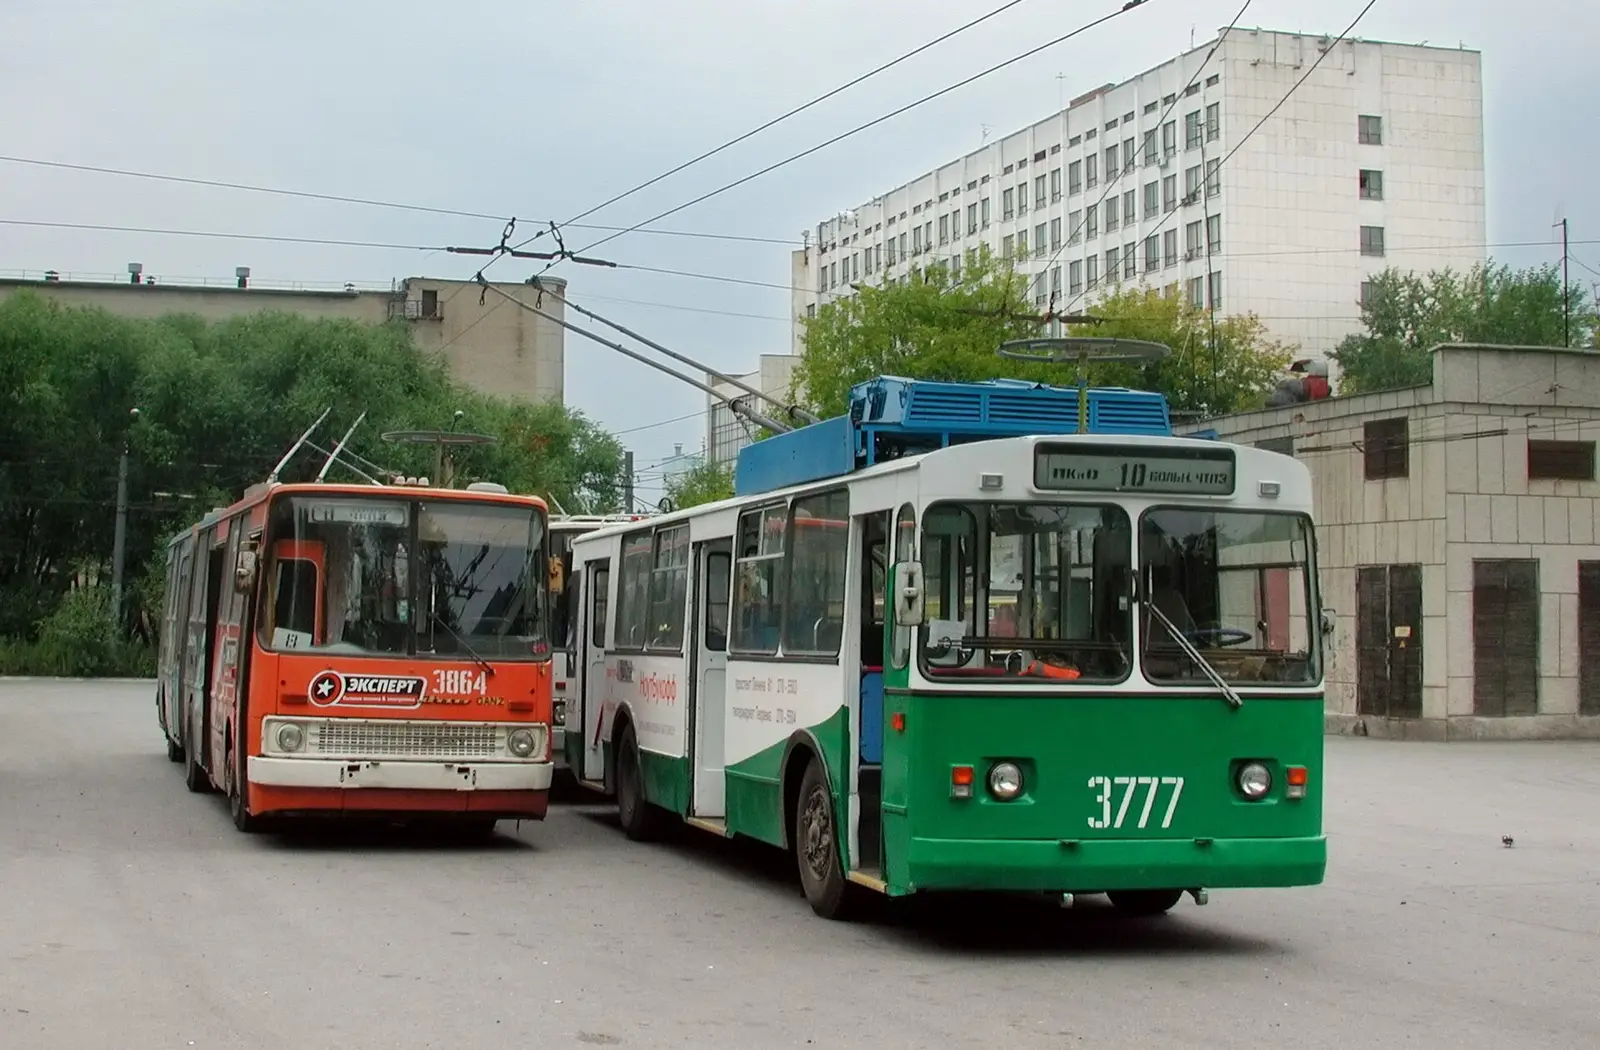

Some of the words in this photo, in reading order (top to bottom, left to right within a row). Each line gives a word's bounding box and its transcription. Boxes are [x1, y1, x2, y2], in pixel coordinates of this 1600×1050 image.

[1121, 463, 1146, 487] 10
[347, 678, 417, 694] ЭКСПЕРТ
[432, 669, 487, 696] 3864
[1087, 776, 1184, 829] 3777
